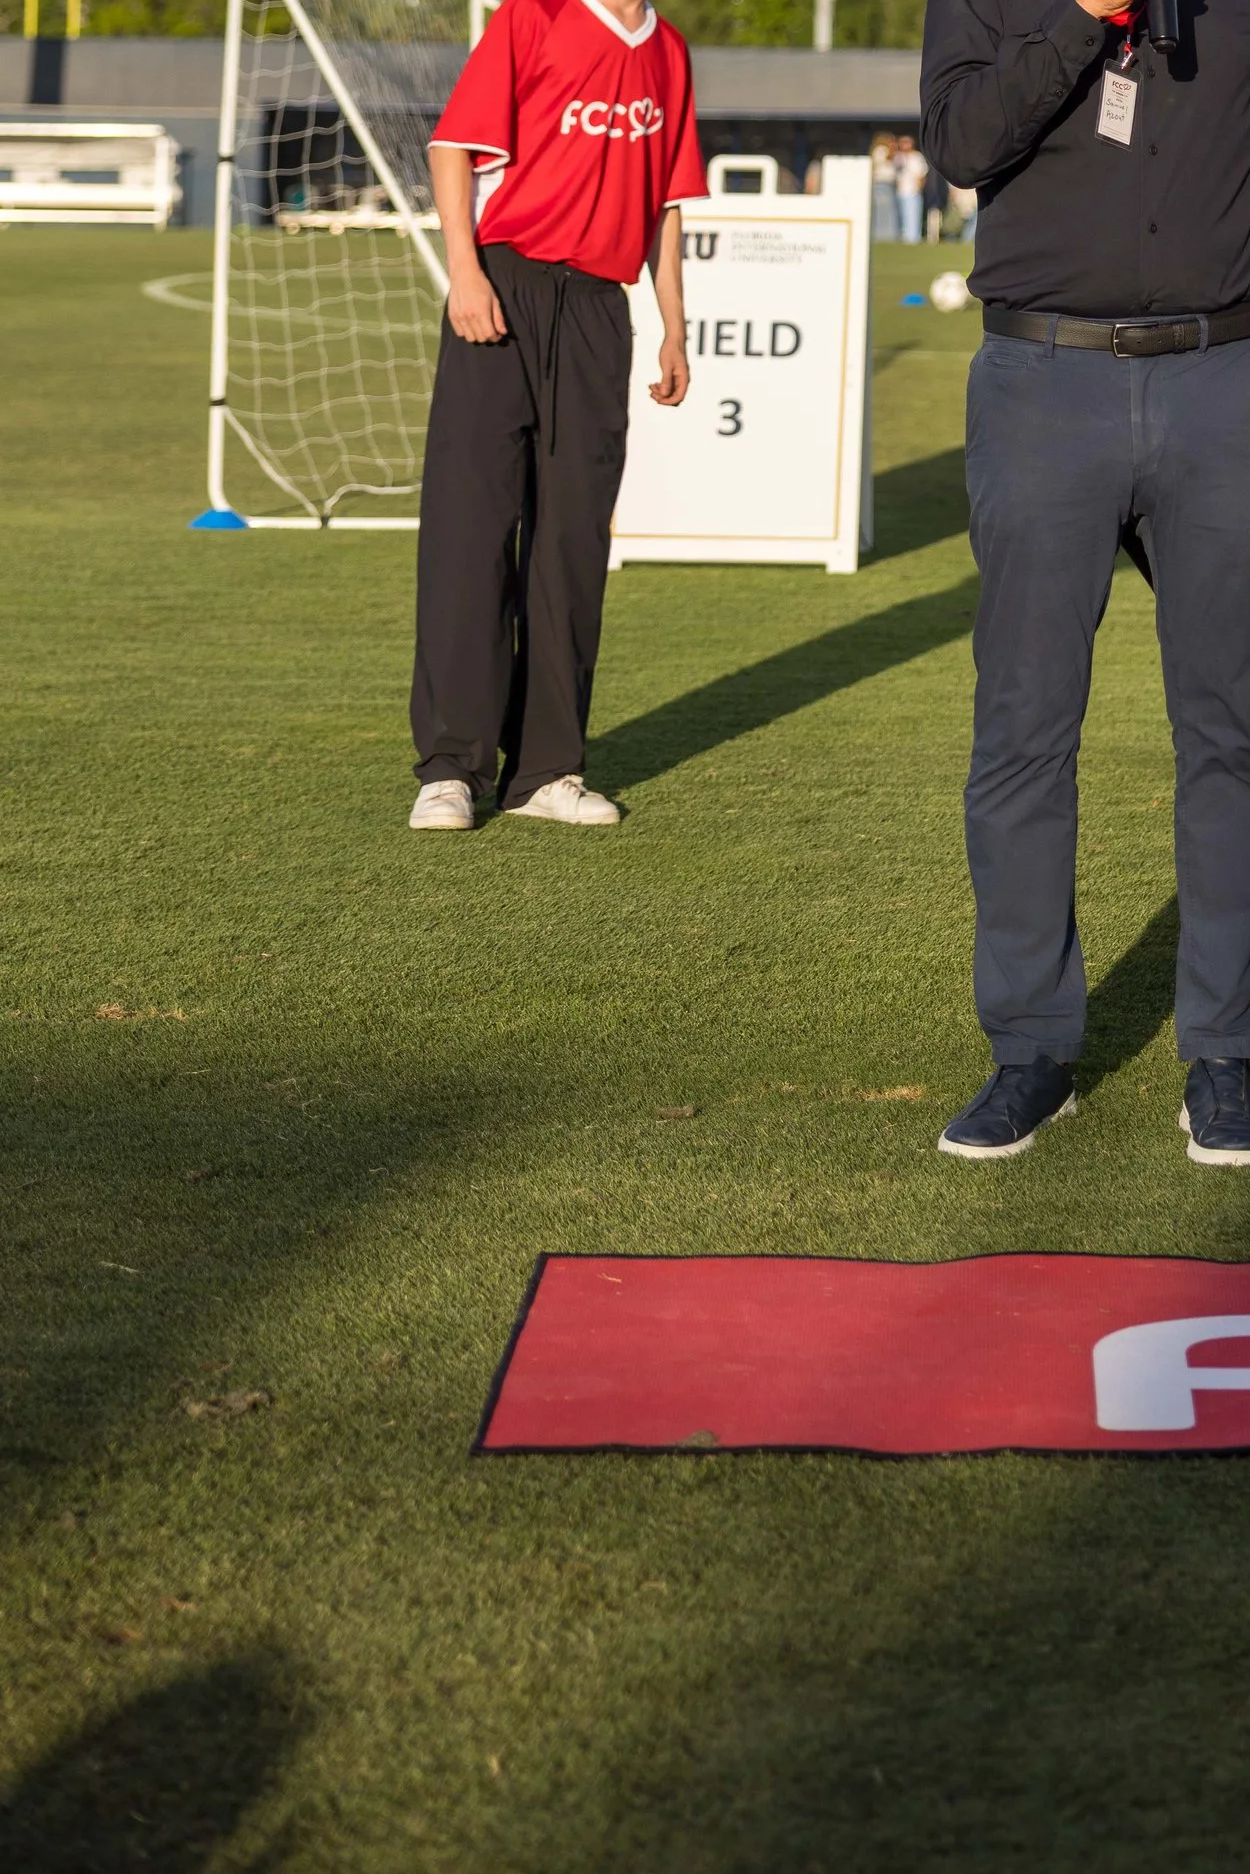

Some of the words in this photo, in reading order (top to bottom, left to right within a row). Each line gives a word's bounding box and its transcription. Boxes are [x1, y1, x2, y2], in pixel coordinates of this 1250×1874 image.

[560, 100, 627, 139] FCC
[682, 232, 719, 260] IU
[686, 320, 802, 357] IELD
[718, 398, 743, 436] 3
